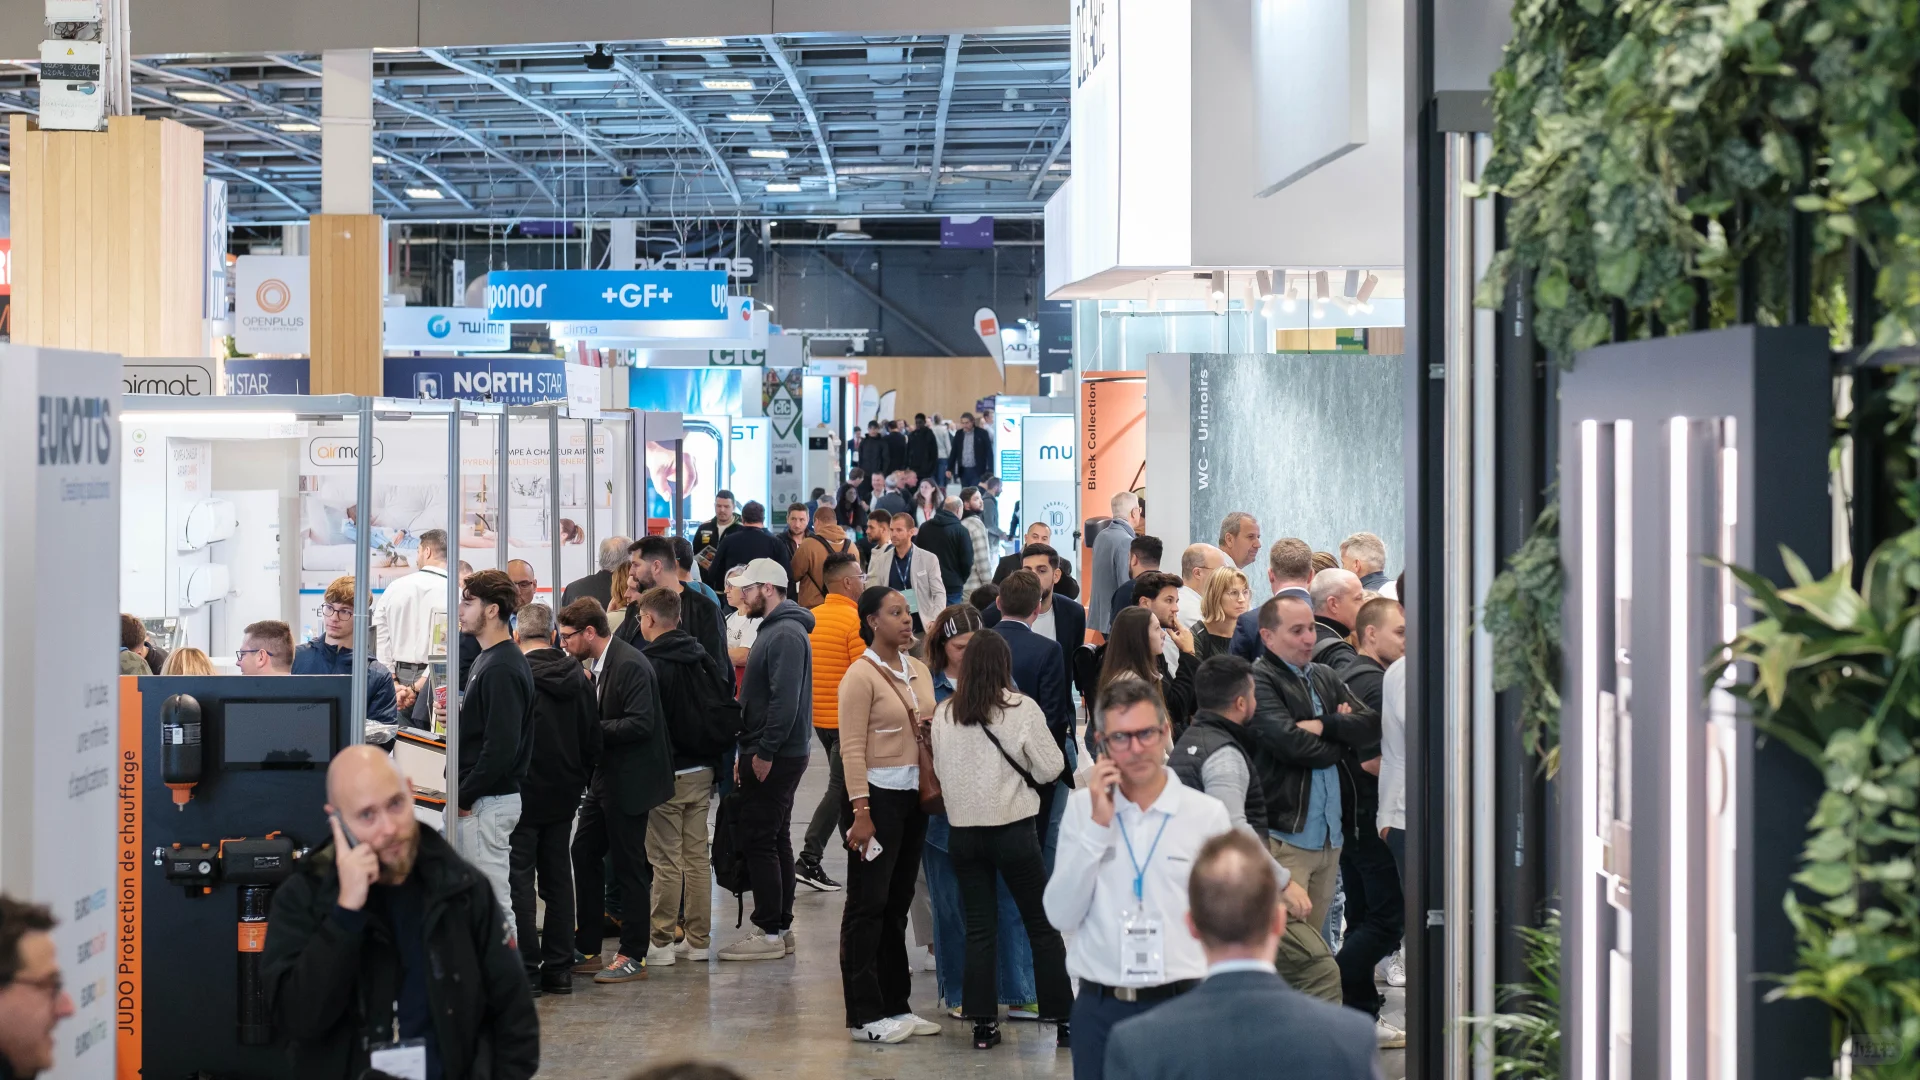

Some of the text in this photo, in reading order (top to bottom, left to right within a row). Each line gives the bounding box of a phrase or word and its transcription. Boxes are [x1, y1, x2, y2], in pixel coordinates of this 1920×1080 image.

[602, 283, 673, 308] +GF+
[243, 317, 304, 326] OPENPLUS
[454, 372, 563, 394] NORTH STAR
[1198, 369, 1209, 440] Urinoirs
[1088, 382, 1096, 490] Black Collection
[495, 448, 524, 456] PMPE
[533, 448, 572, 456] CHAEUR
[1198, 459, 1209, 490] WC
[1049, 511, 1064, 527] 10
[118, 750, 139, 1036] JUDO Protection de chauffage
